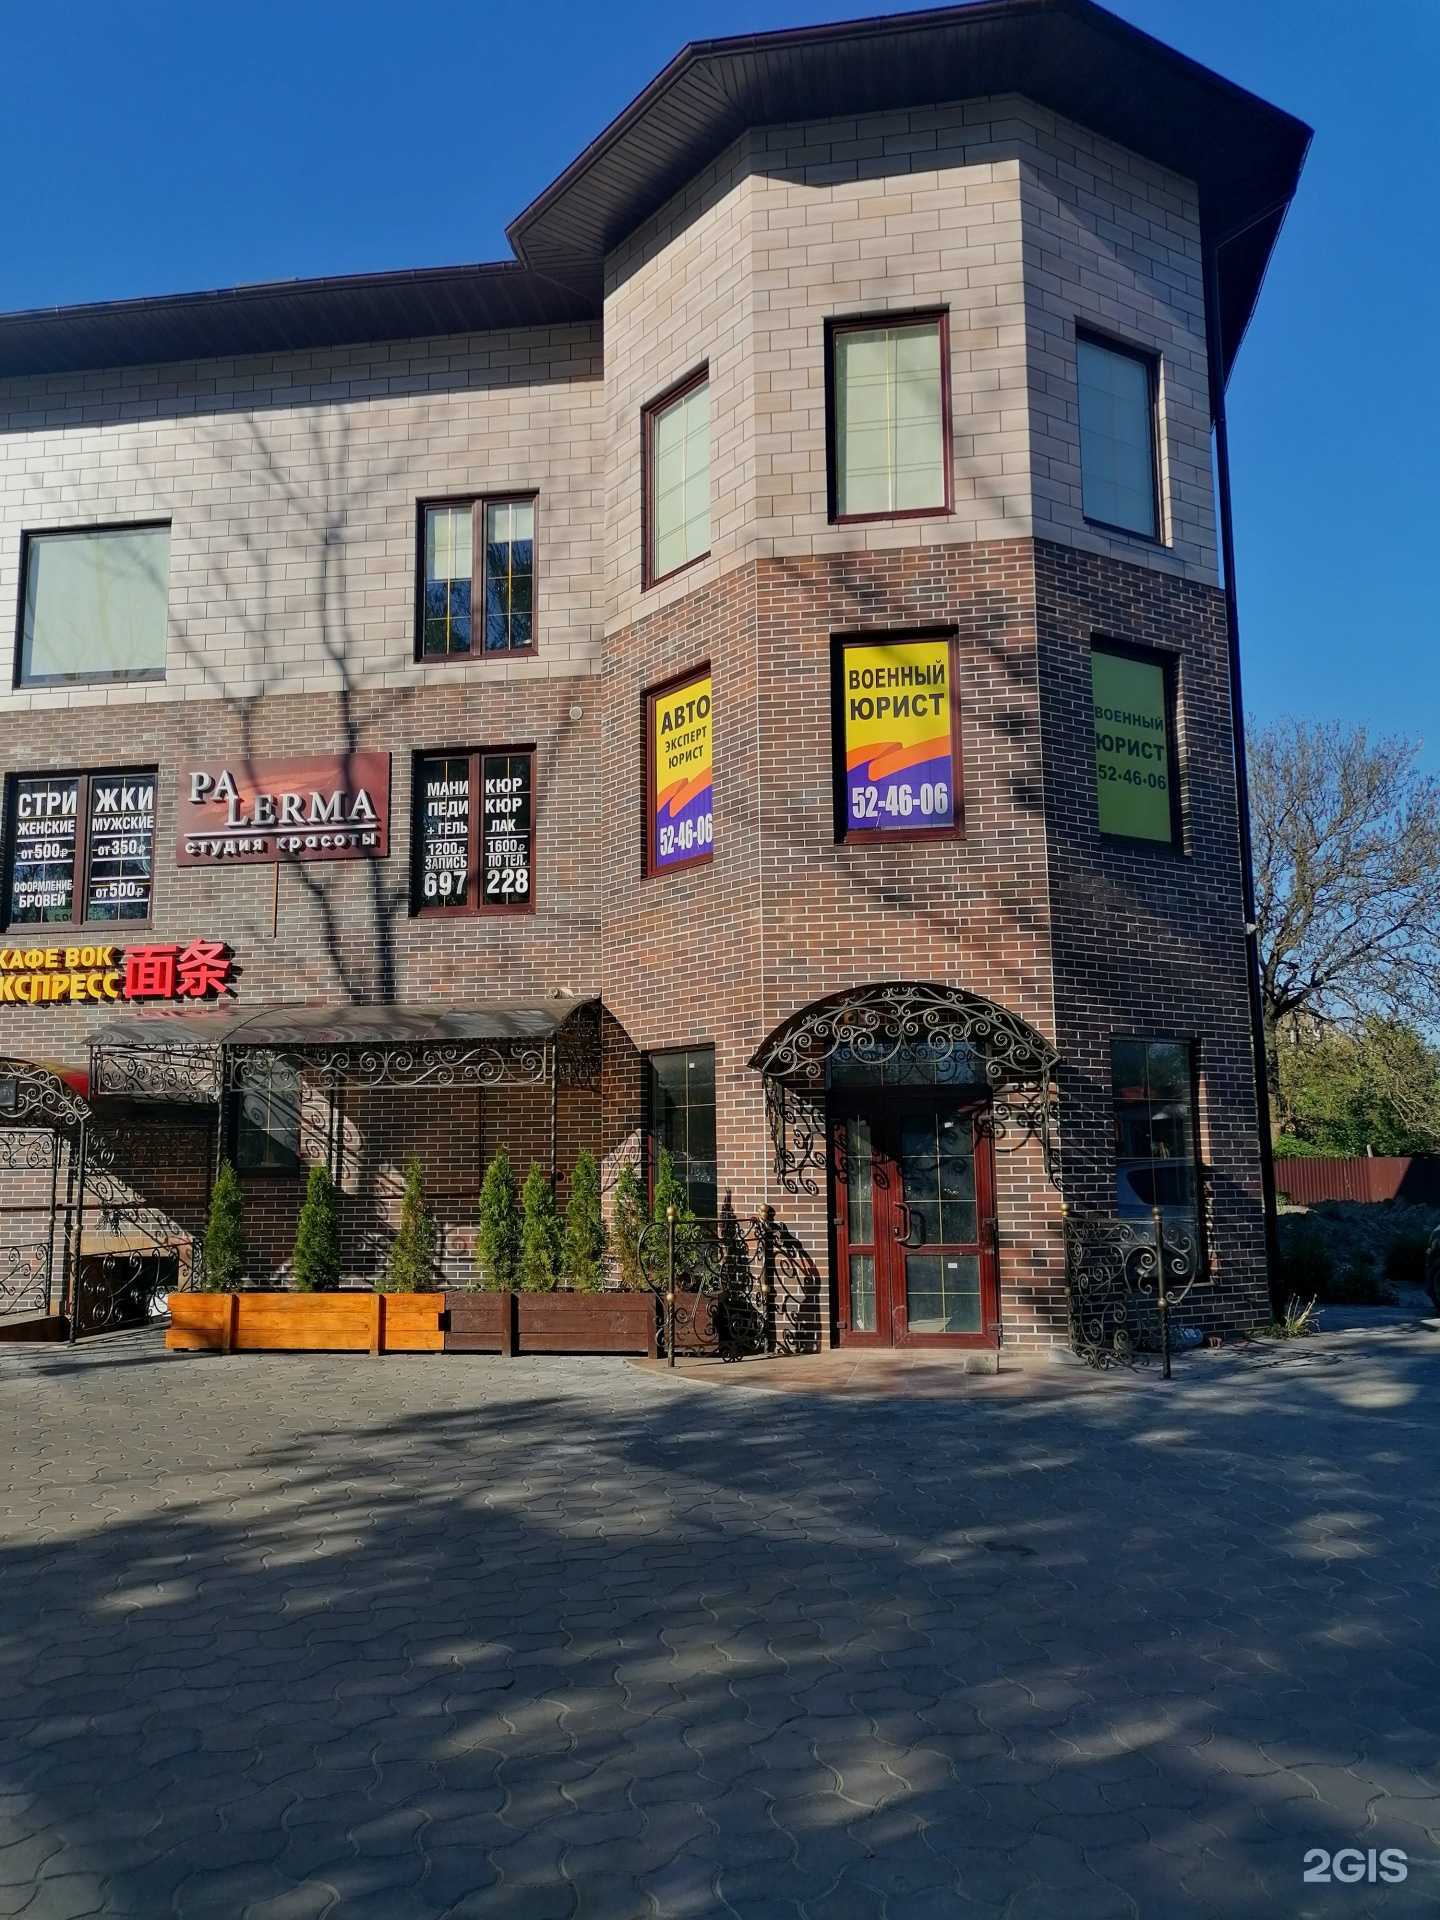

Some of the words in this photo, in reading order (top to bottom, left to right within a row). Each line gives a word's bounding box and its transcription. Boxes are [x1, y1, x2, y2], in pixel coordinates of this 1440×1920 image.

[849, 659, 945, 690] ВОЕННЫЙ
[660, 694, 711, 736] АВТО
[850, 692, 945, 721] ЮРИСТ
[1094, 706, 1164, 732] ВОЕННЫЙ
[664, 725, 708, 753] ЭКСПЕРТ
[1096, 732, 1165, 761] ЮРИСТ
[668, 745, 704, 769] ЮРИСТ
[188, 768, 240, 802] PA
[427, 780, 469, 796] МАНИ
[485, 777, 523, 793] КЮР
[18, 791, 78, 817] СТРИ
[95, 786, 154, 813] ЖКИ
[224, 788, 377, 827] LERMA
[427, 800, 469, 817] ПЕДИ
[485, 797, 523, 813] КЮР
[852, 782, 948, 819] 52-46-06
[17, 820, 76, 836] ЖЕНСКИЕ
[92, 816, 155, 832] МУЖСКИЕ
[438, 821, 468, 835] ГЕЛЬ
[490, 818, 516, 833] ЛАК
[659, 812, 713, 857] 52-46-06
[185, 837, 264, 857] студия
[276, 832, 376, 852] красоты
[425, 855, 467, 870] ЗАПИСЬ
[488, 855, 502, 867] ПО
[14, 879, 73, 893] ОФОРМЛЕНИЕ
[424, 871, 467, 897] 697
[486, 868, 529, 894] 228
[19, 890, 66, 908] БРОВЕЙ
[64, 946, 113, 967] ВОК
[124, 938, 230, 998] 面条
